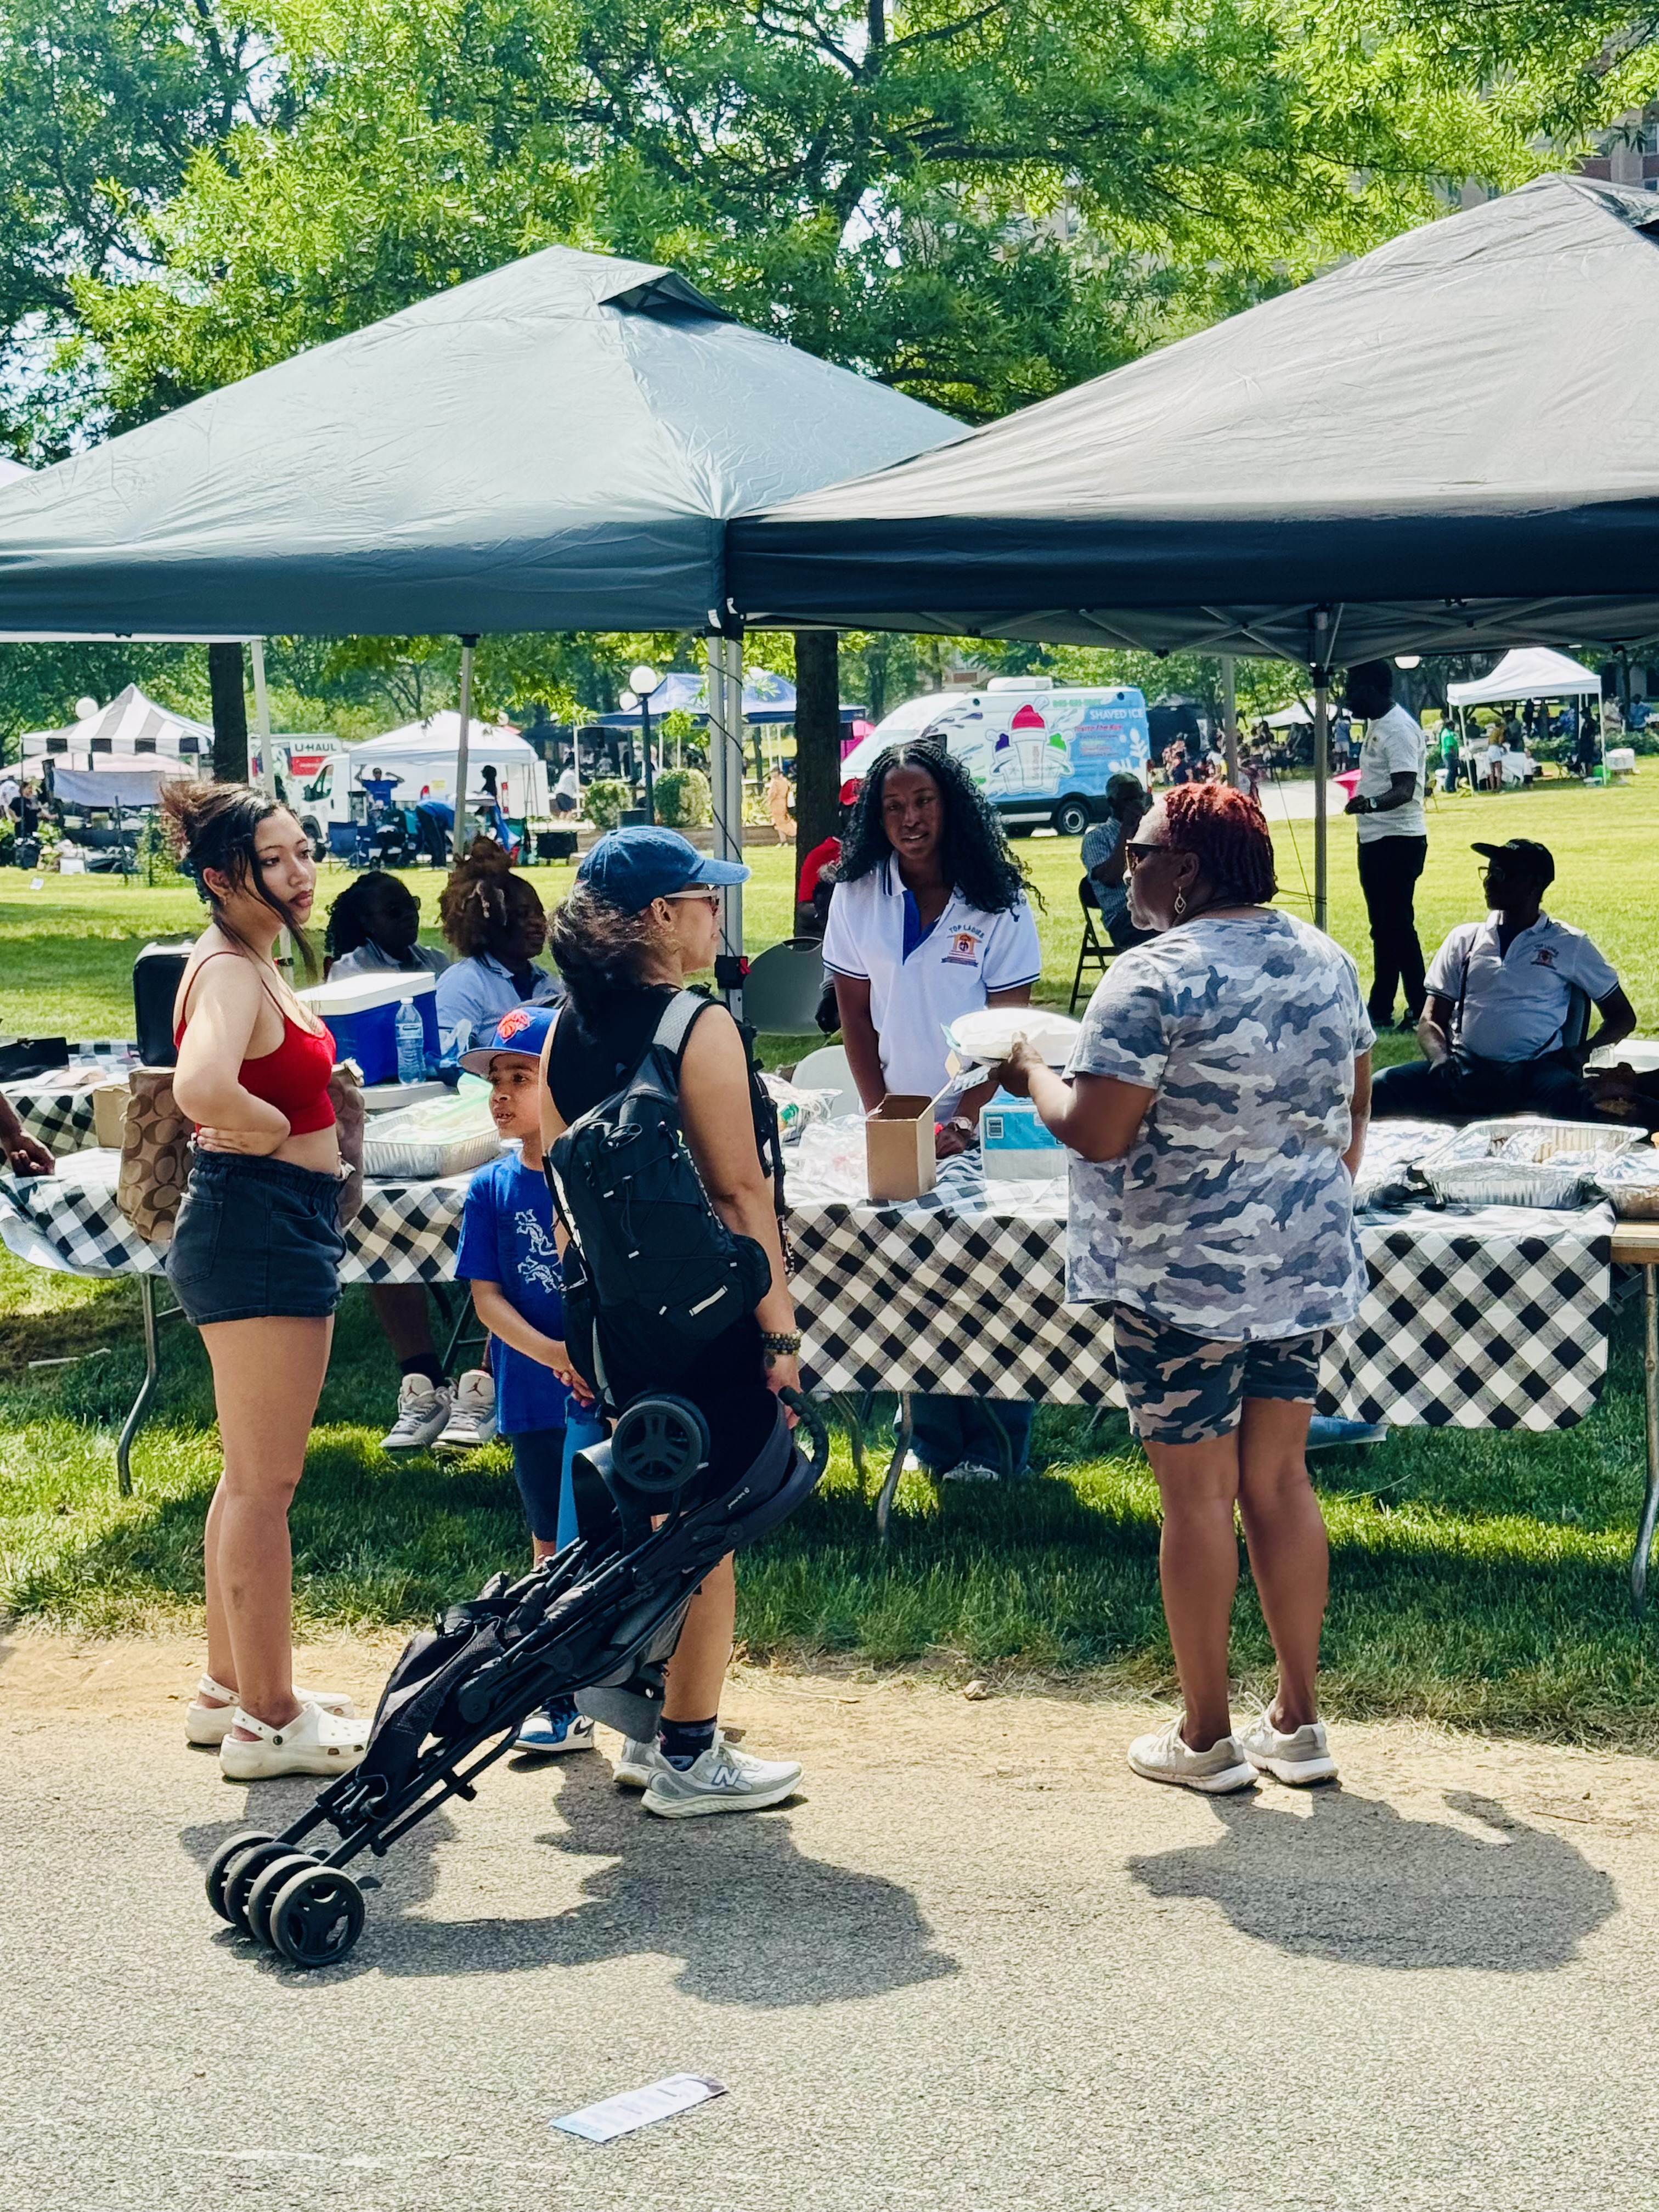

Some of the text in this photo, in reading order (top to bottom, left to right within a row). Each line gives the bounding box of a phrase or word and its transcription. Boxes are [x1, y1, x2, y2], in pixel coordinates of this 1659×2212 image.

[1090, 708, 1144, 720] SHAVED ICE
[949, 924, 961, 933] TOP
